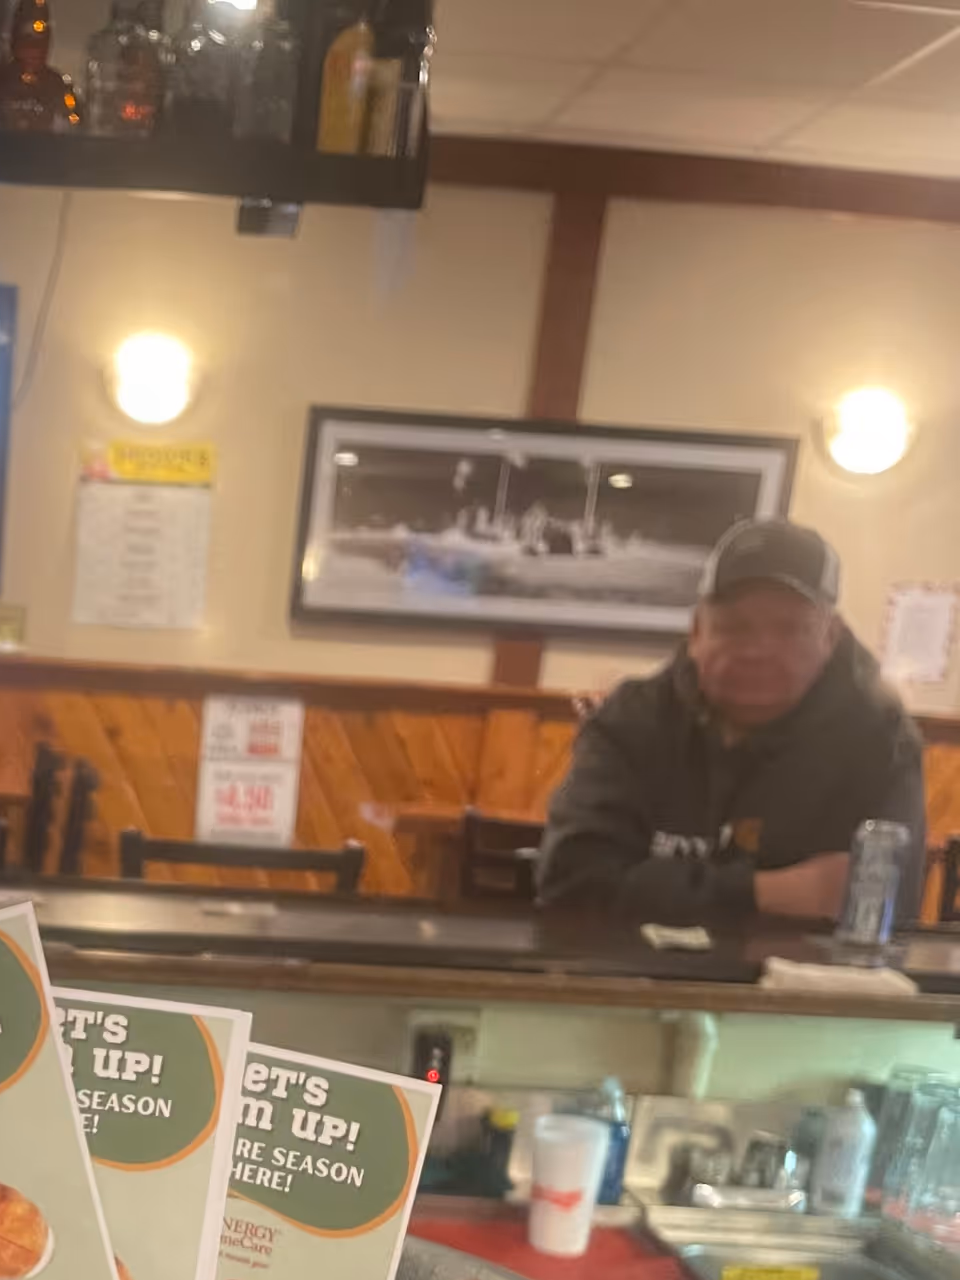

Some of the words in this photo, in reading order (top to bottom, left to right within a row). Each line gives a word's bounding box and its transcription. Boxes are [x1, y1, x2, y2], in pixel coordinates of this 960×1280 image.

[77, 1089, 172, 1118] SEASON
[235, 1138, 266, 1162] RE
[271, 1147, 365, 1188] SEASON
